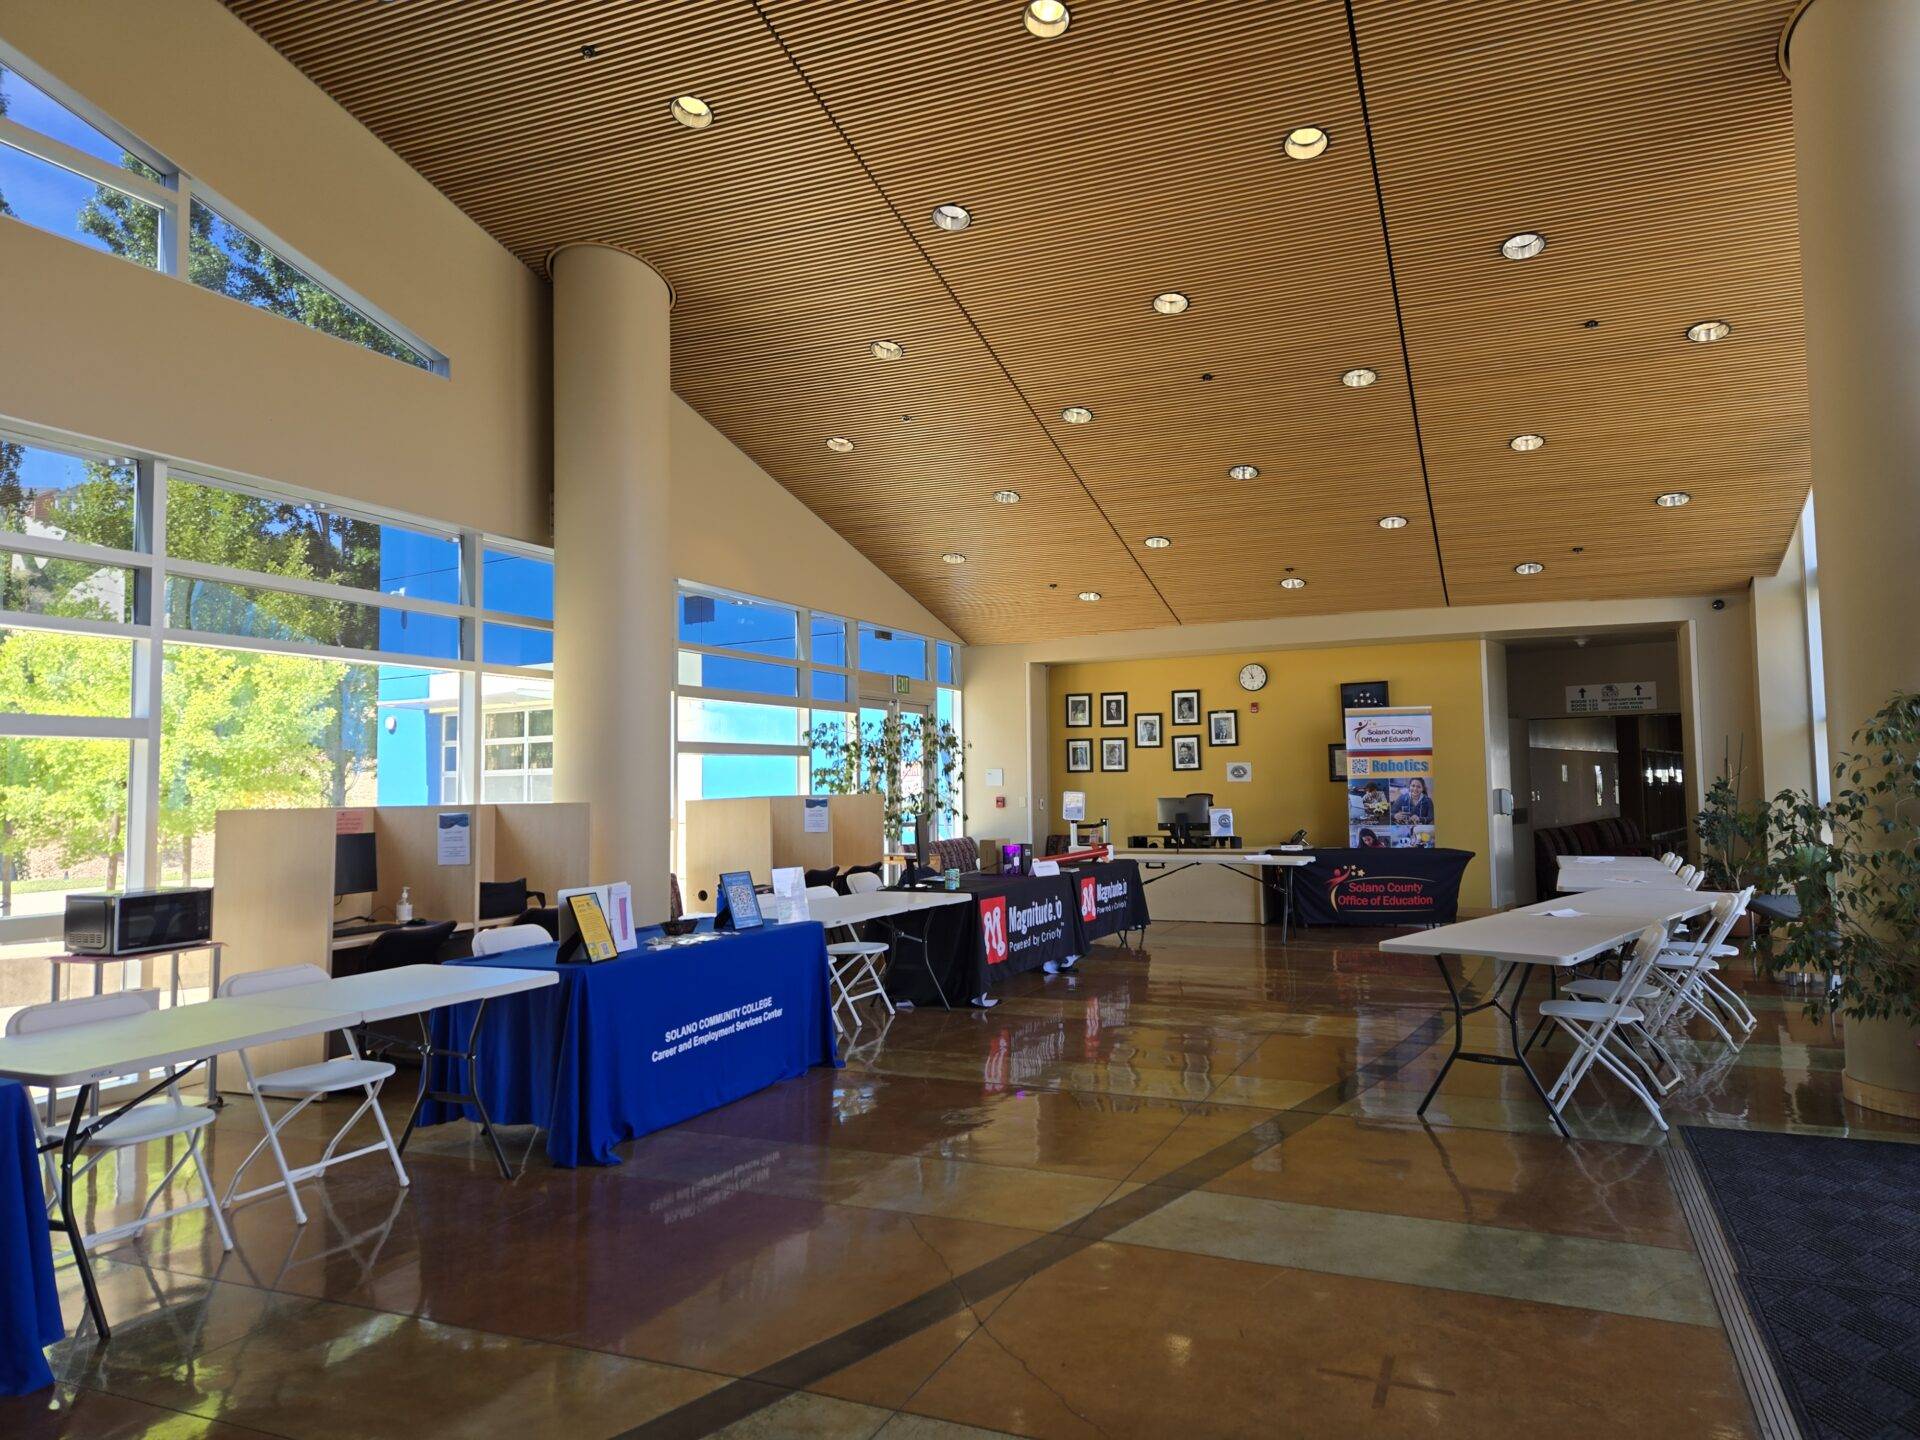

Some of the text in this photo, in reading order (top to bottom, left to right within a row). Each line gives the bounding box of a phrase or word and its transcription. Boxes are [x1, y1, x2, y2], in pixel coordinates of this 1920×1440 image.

[1367, 728, 1414, 736] Solano County
[1361, 736, 1381, 744] Office
[1389, 735, 1421, 743] Education
[1372, 759, 1428, 773] Robotics
[1349, 882, 1423, 893] Solano County
[1338, 895, 1433, 906] Office of Education
[1009, 895, 1062, 935] Magnitude.io
[1032, 934, 1040, 947] by
[665, 996, 773, 1043] SOLANO COMMUNITY COLLEGE
[652, 1008, 783, 1063] Career and Employment Services Center
